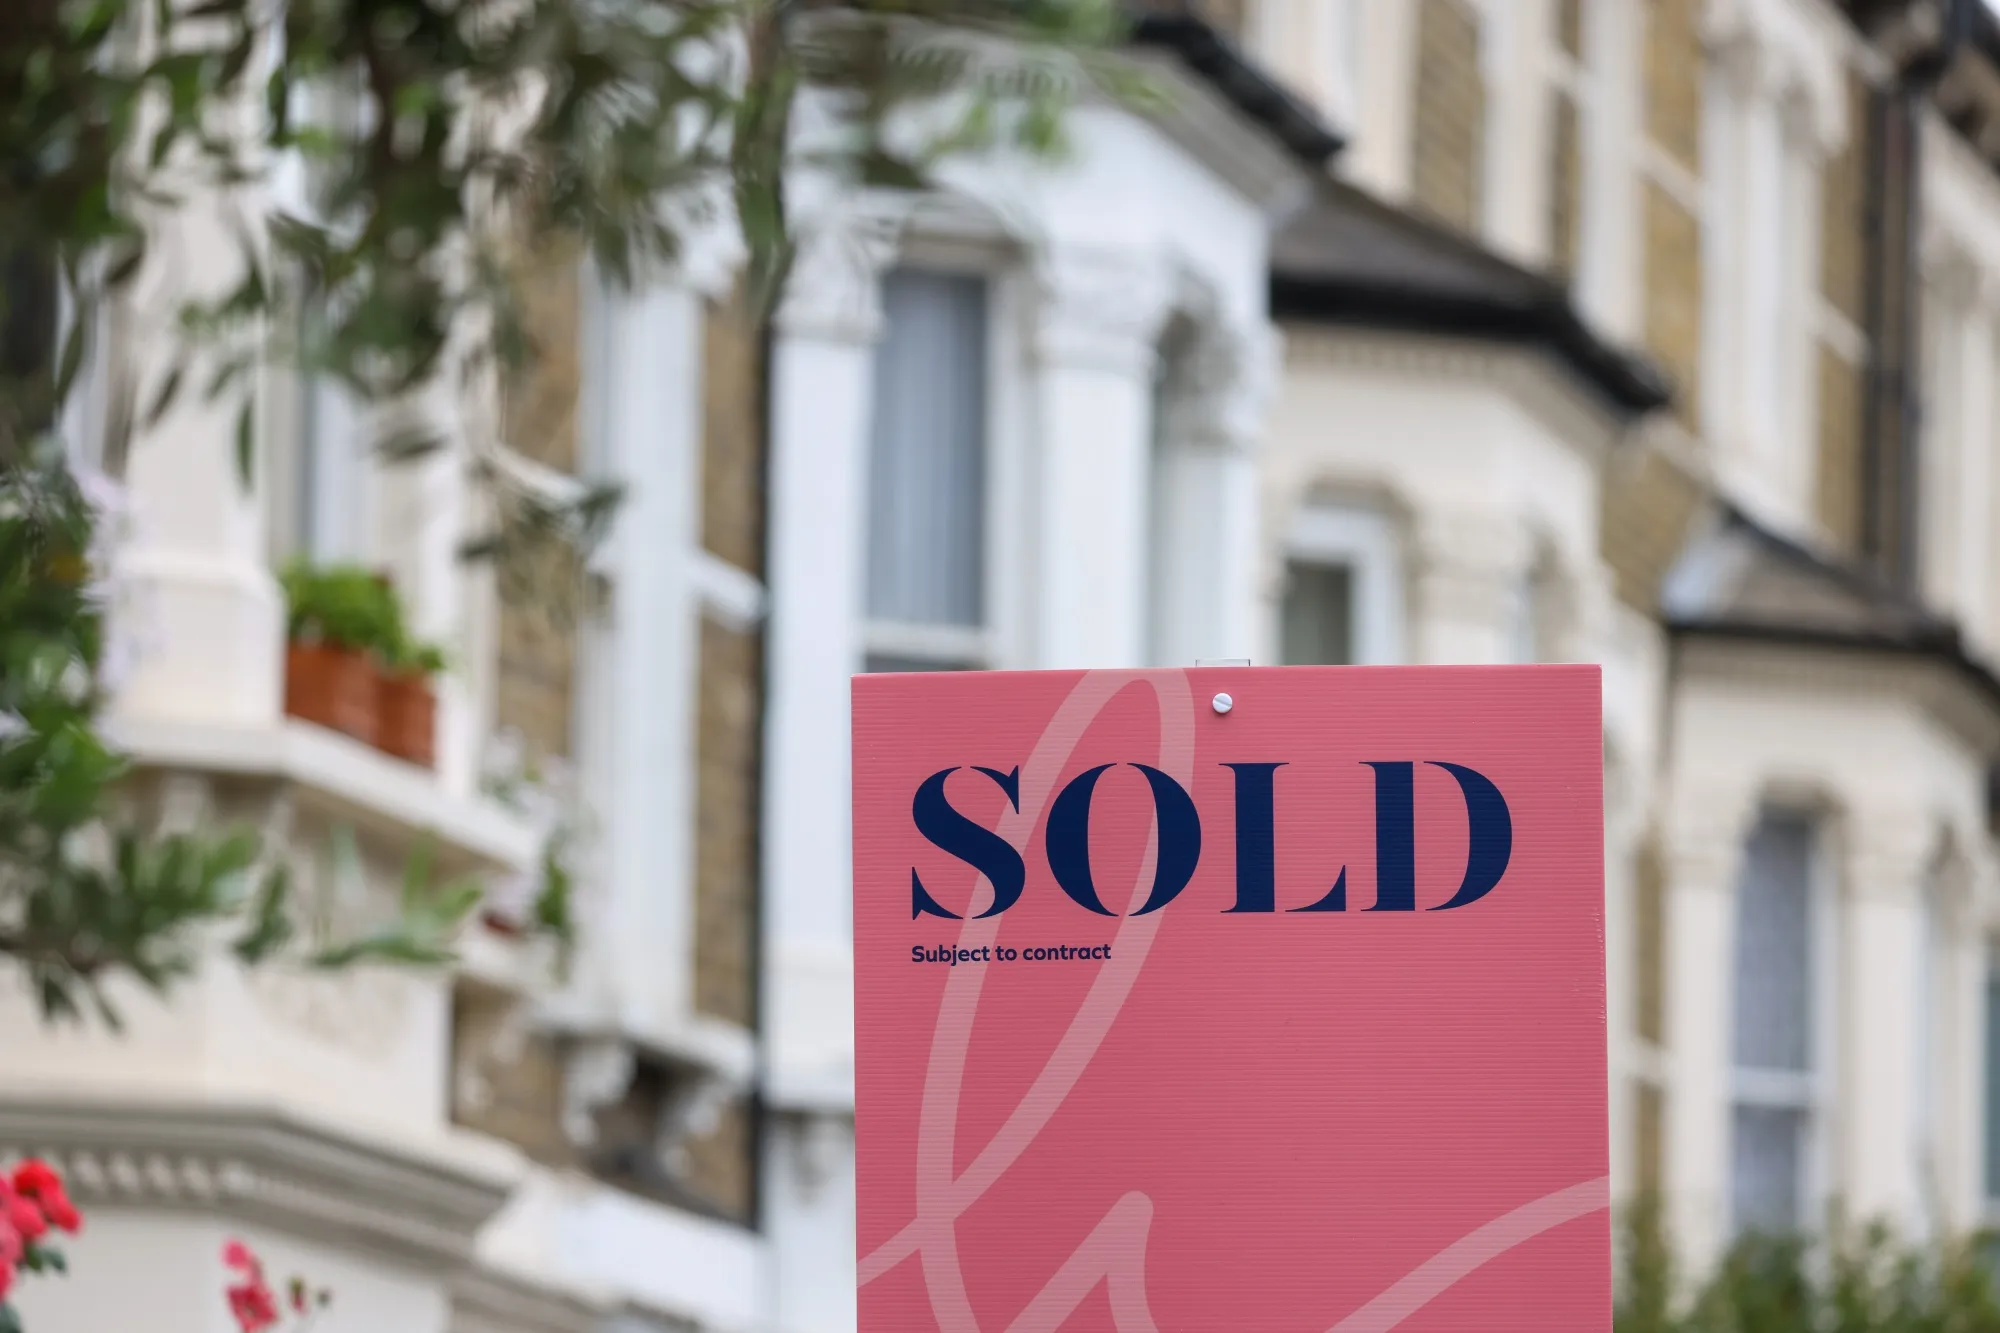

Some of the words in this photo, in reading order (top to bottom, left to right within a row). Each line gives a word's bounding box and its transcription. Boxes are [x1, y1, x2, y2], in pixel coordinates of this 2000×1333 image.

[911, 760, 1513, 921] SOLD
[911, 944, 991, 967] Subject
[994, 945, 1018, 962] to
[1022, 943, 1112, 961] contract
